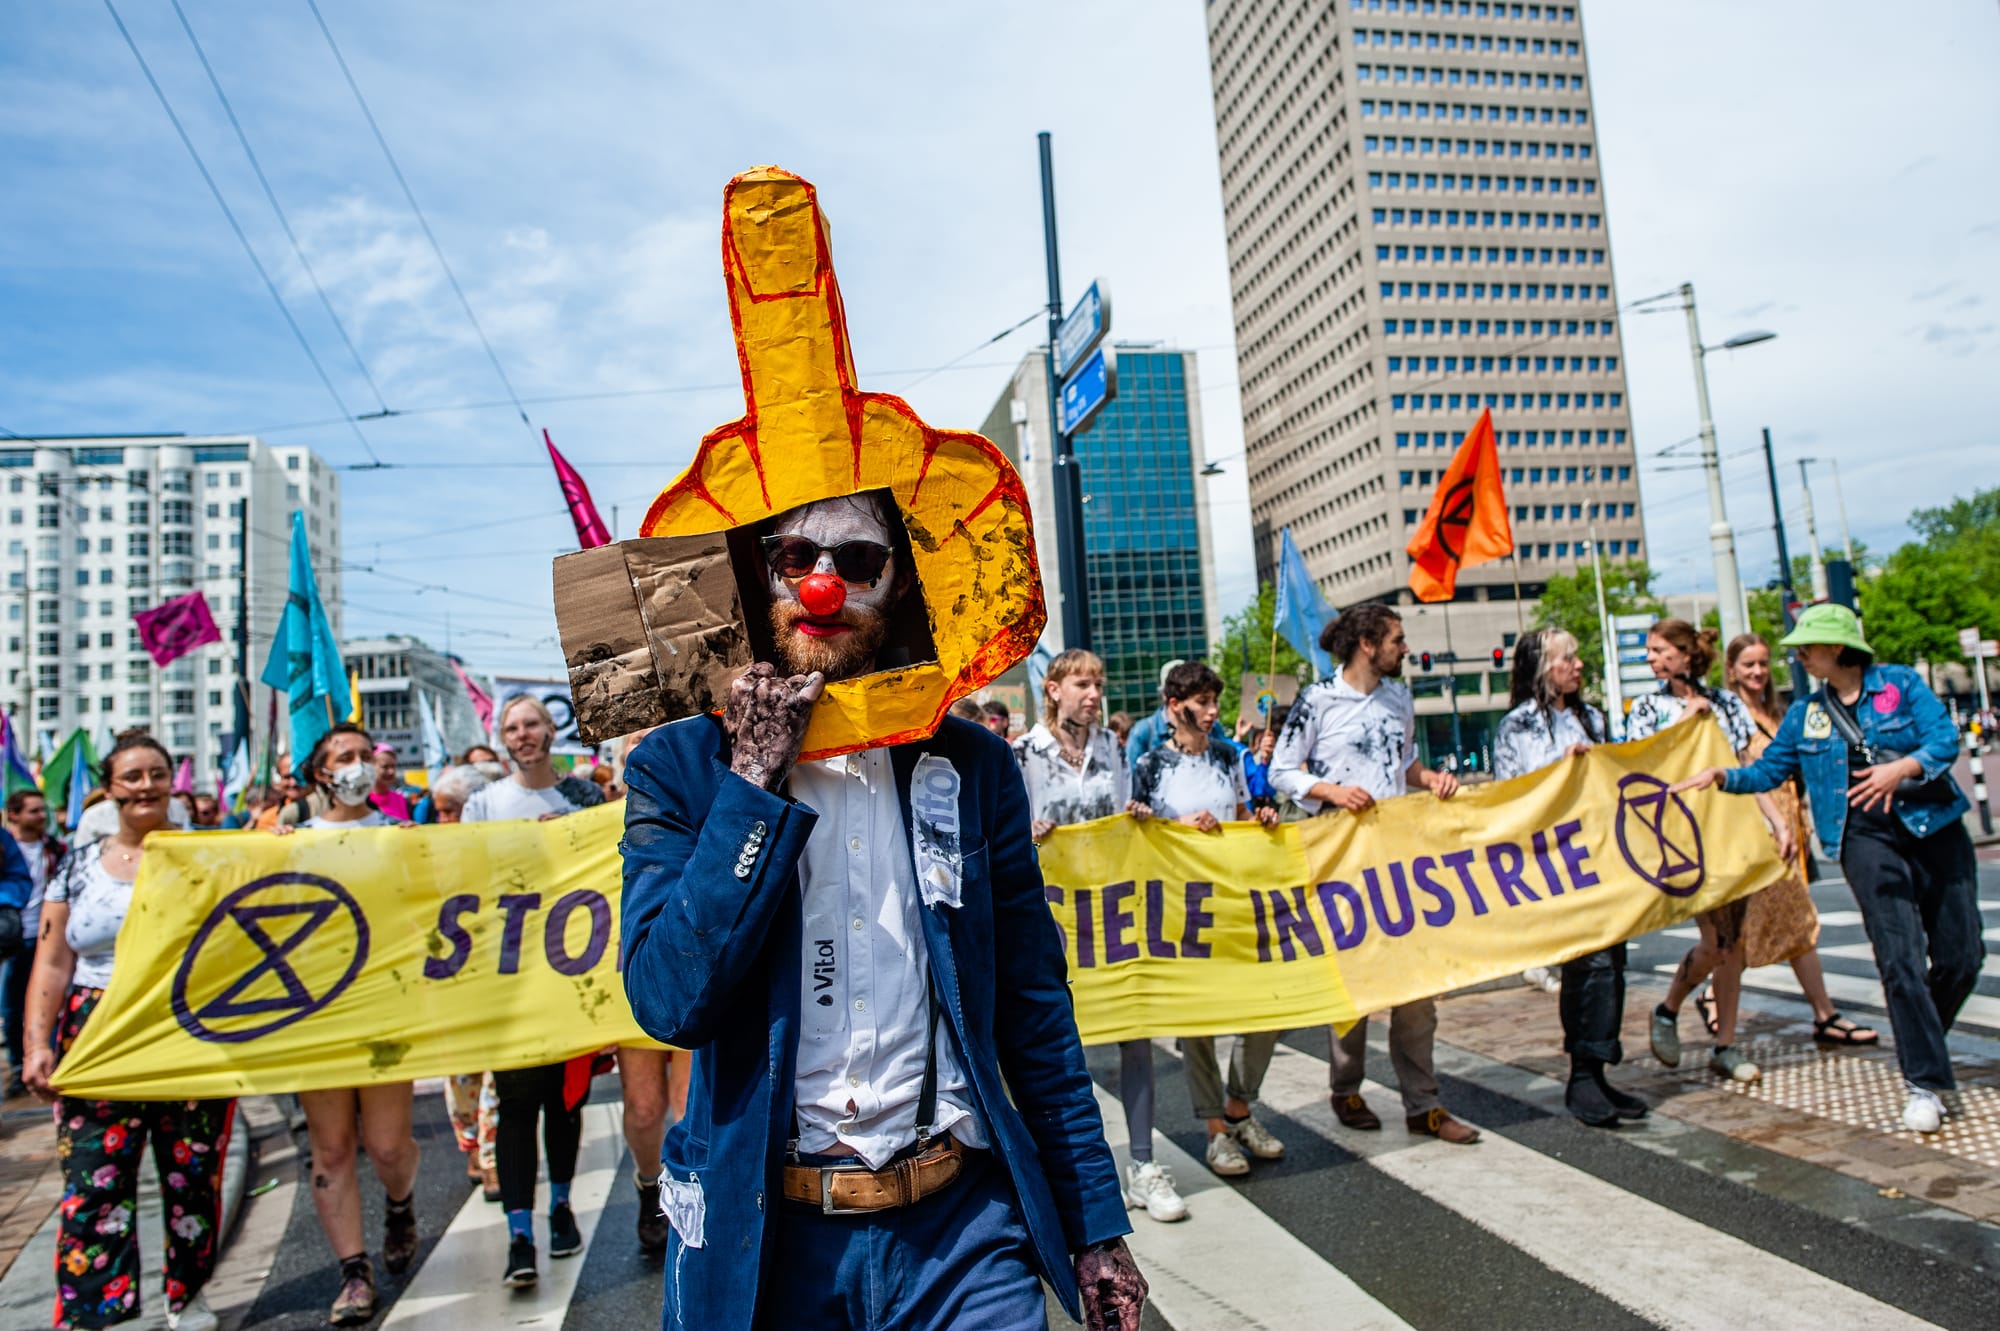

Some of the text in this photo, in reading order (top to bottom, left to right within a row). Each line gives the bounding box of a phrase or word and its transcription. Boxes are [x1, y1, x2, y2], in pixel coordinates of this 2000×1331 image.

[423, 889, 622, 980] STO
[1249, 818, 1601, 962] INDUSTRIE
[813, 938, 835, 992] Vitol
